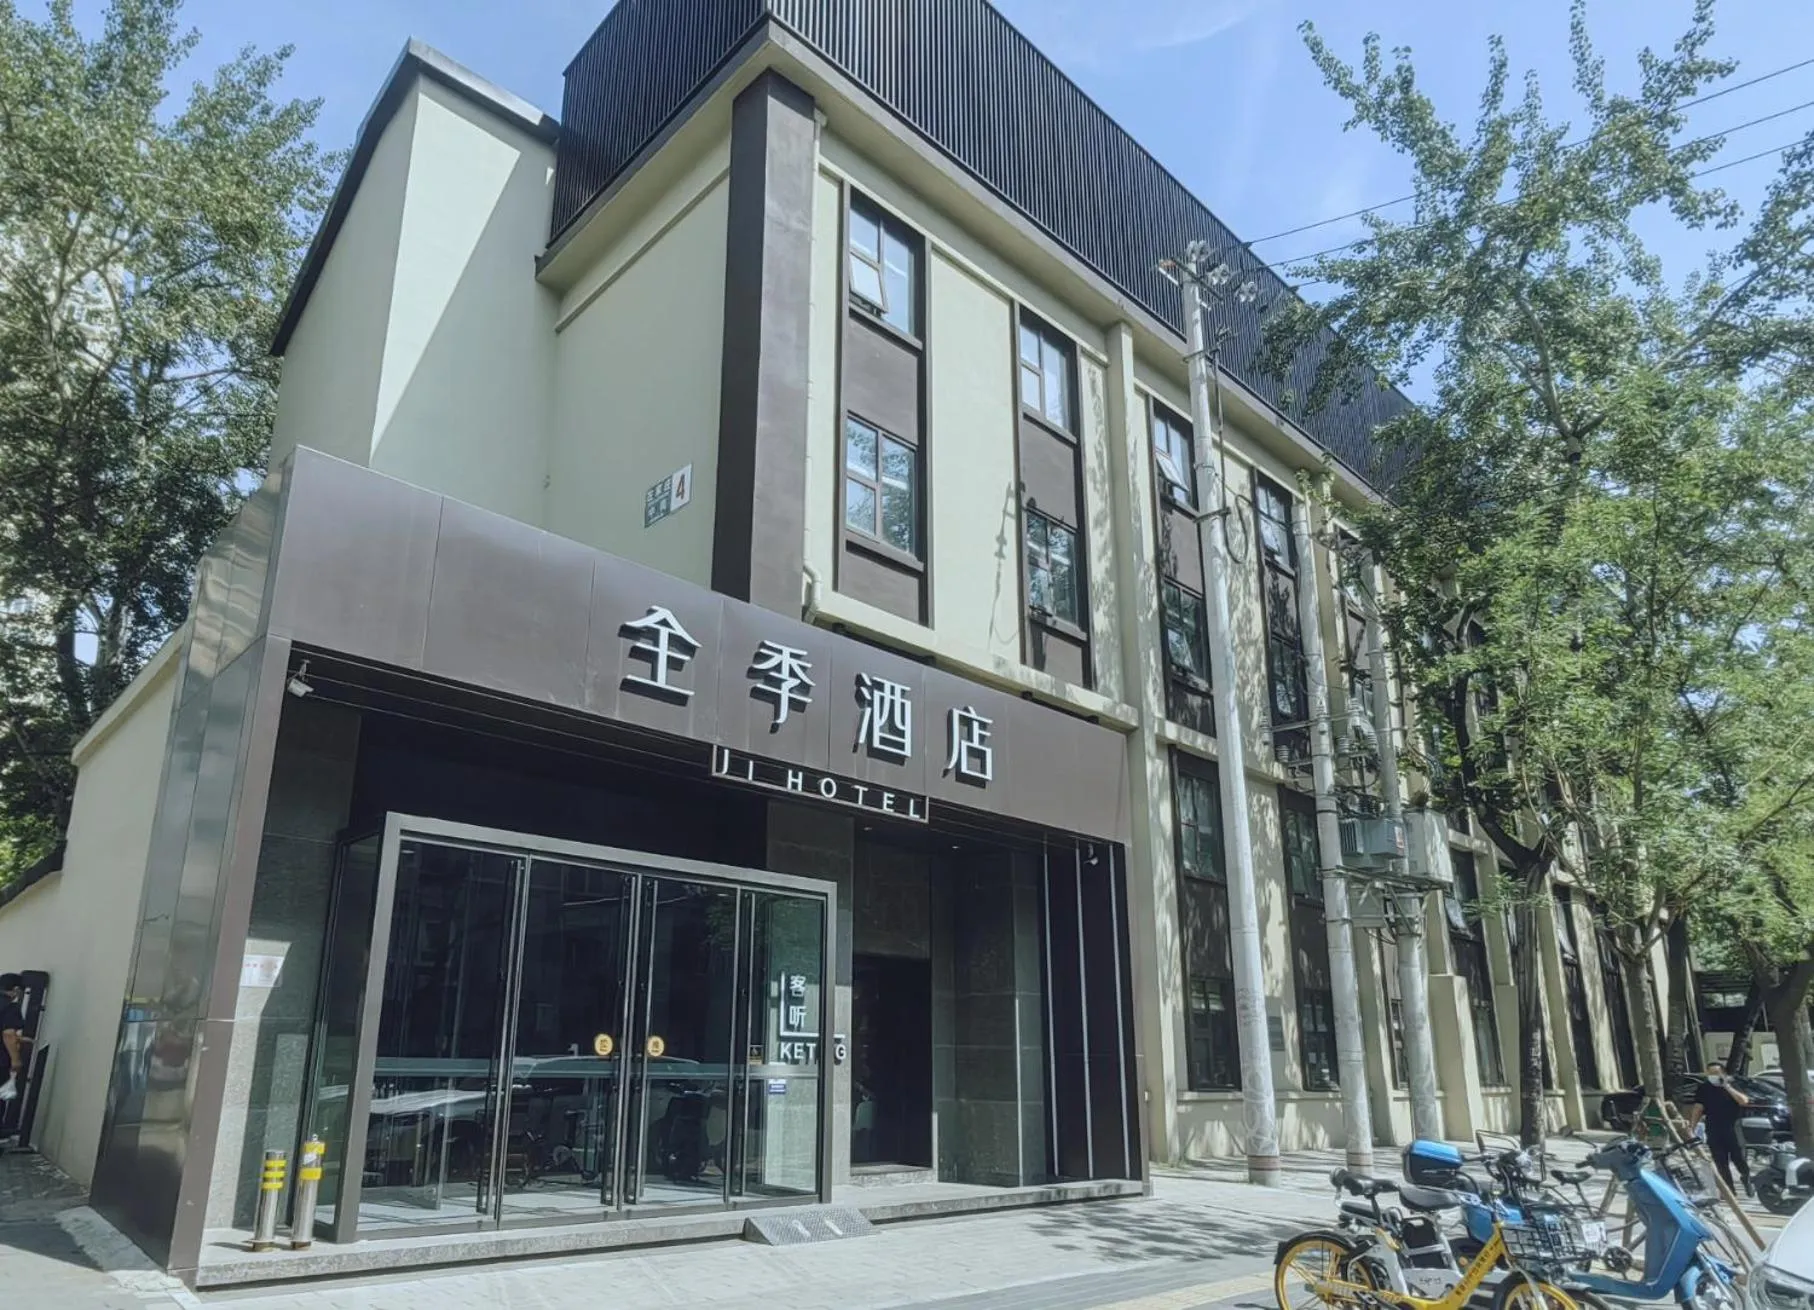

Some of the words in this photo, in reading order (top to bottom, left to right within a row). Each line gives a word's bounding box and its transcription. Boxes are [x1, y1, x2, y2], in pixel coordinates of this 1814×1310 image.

[675, 473, 686, 500] 4
[624, 605, 994, 781] 全季酒店
[719, 748, 754, 781] JI
[787, 769, 921, 819] HOTEL
[789, 974, 807, 1029] 客听
